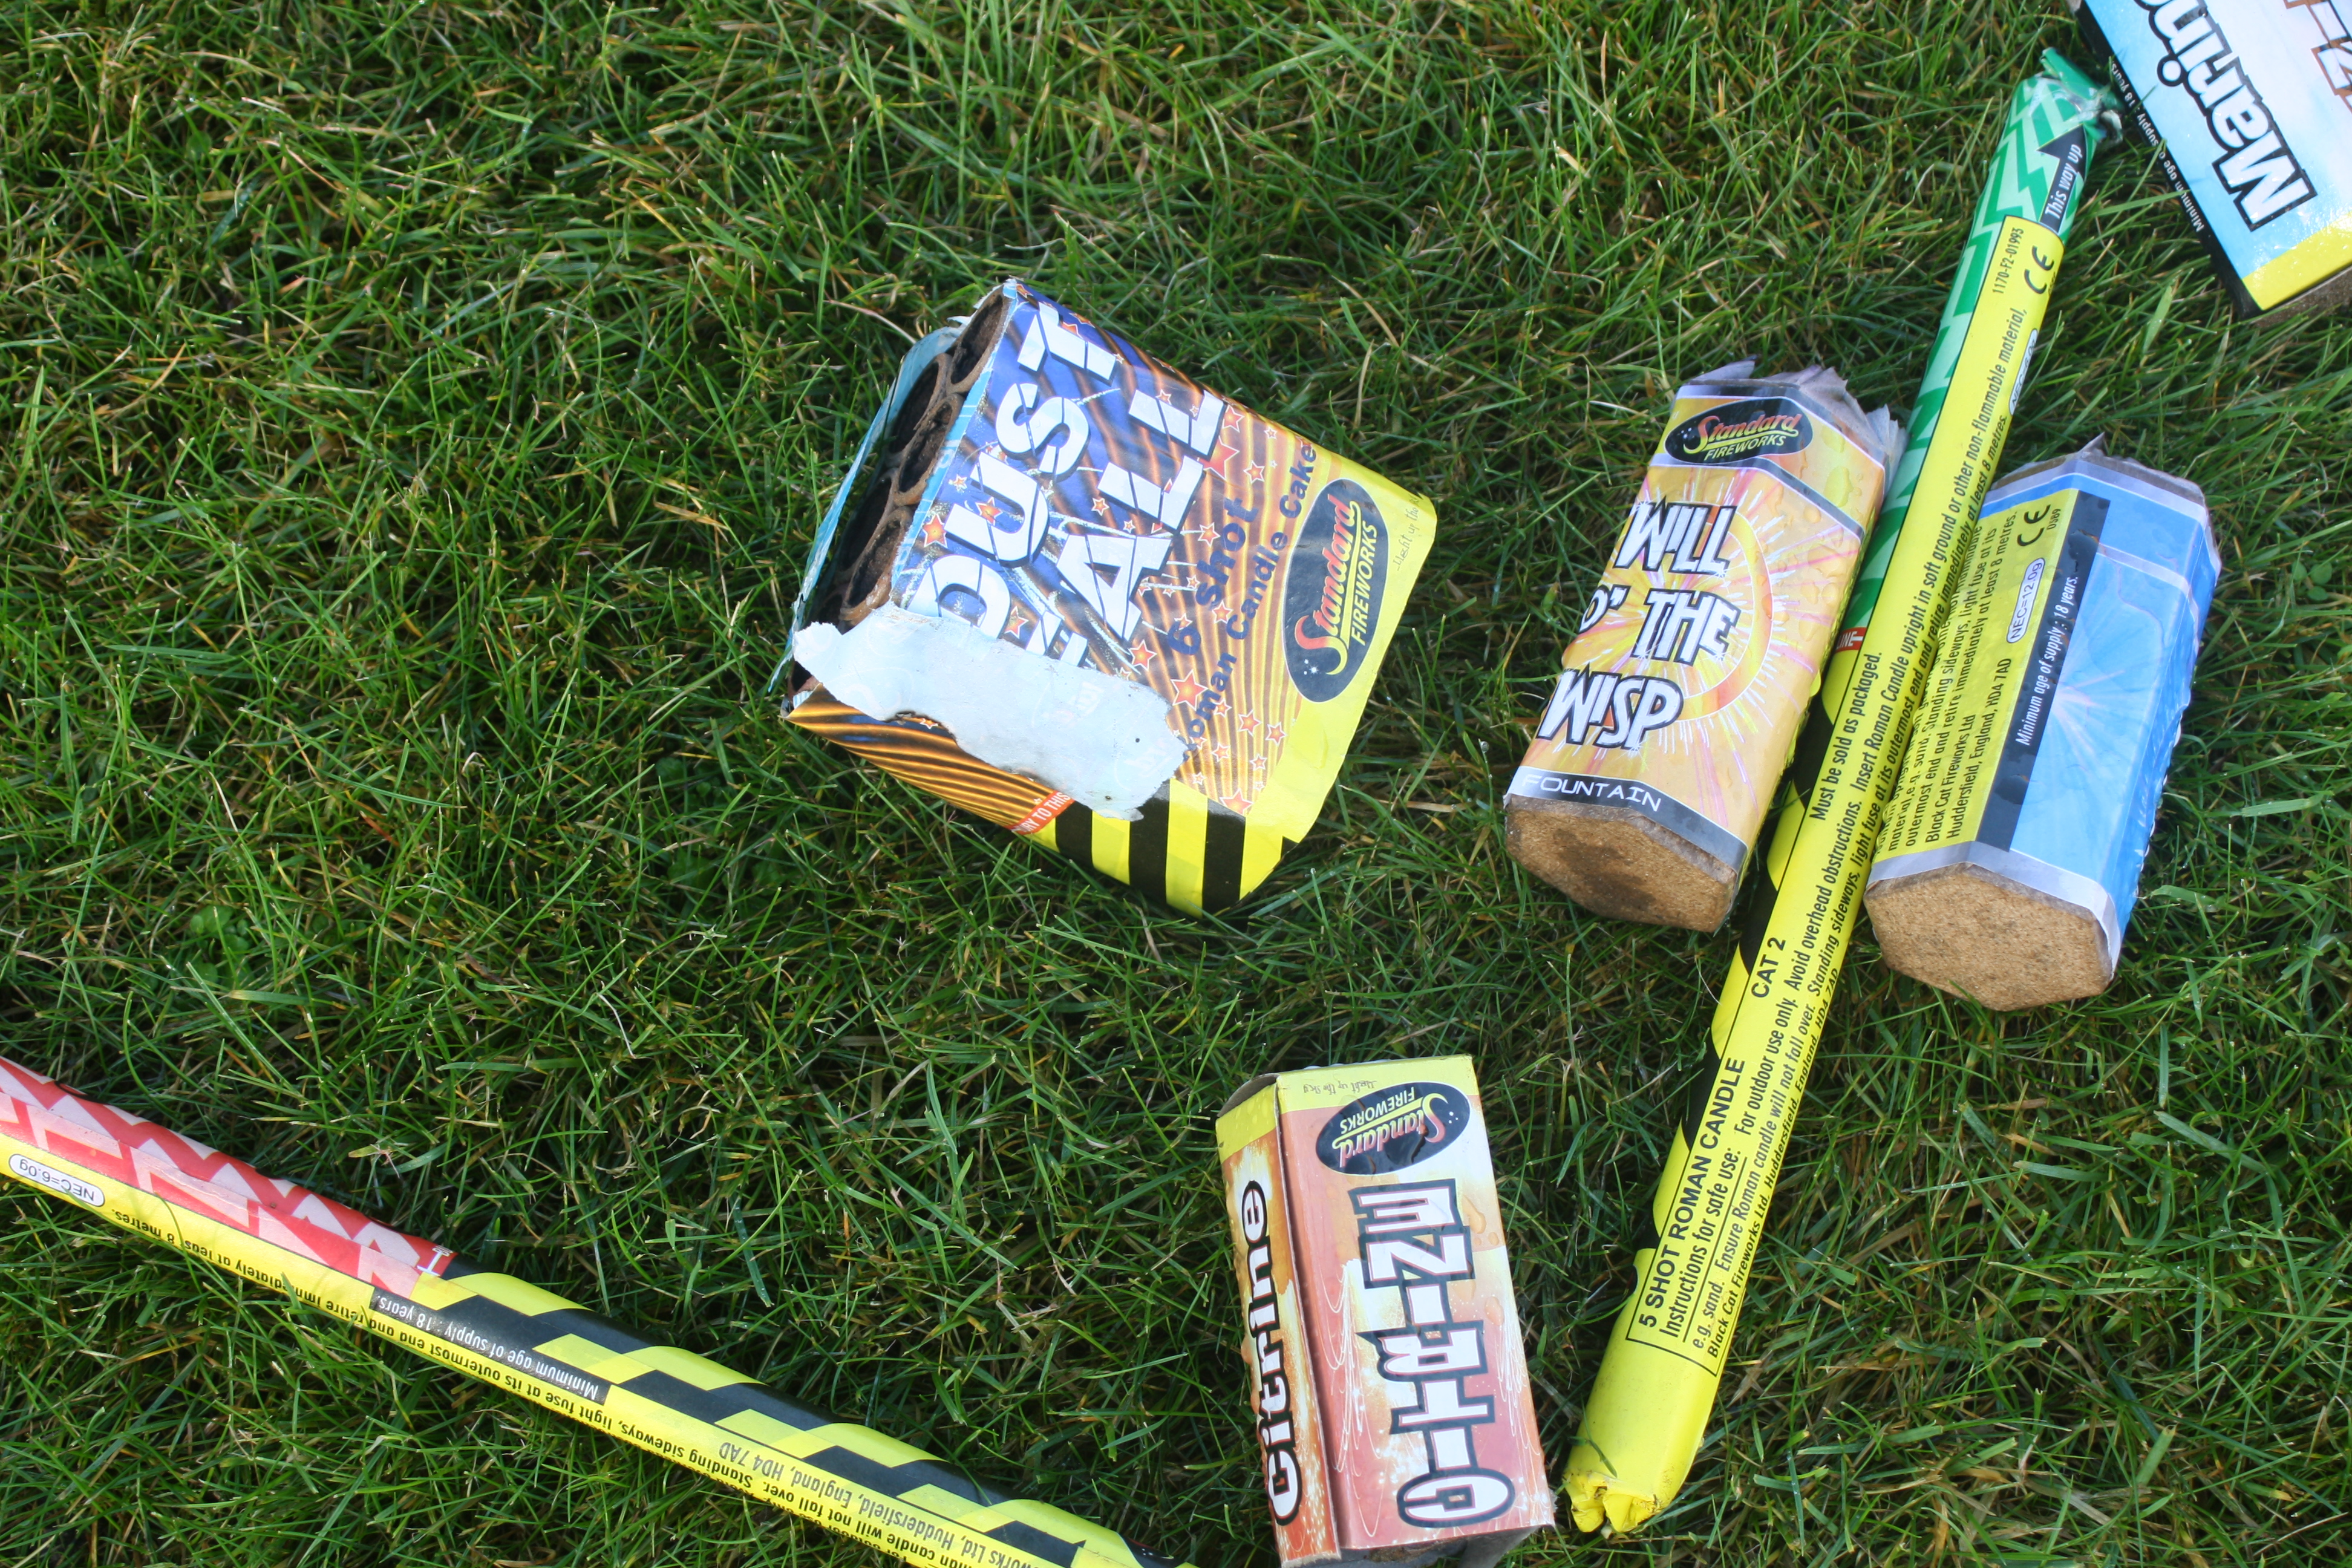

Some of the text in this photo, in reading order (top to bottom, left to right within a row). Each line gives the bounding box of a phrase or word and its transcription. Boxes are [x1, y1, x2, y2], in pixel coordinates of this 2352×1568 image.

[2135, 0, 2316, 230] Marin
[2124, 91, 2178, 181] age supply 18
[2044, 143, 2082, 218] This way up
[1991, 227, 2024, 293] 1170-F2-01993
[2024, 246, 2054, 295] CE
[1998, 307, 2027, 363] material,
[1965, 364, 2006, 461] non-flammable
[1683, 413, 1803, 454] Standard
[1704, 434, 1786, 462] FIREWORKS
[1987, 415, 2007, 462] metres.
[906, 302, 1117, 639] DUST
[1953, 460, 1973, 497] other
[1981, 460, 1991, 472] 8
[1948, 497, 1962, 513] or
[1969, 471, 1988, 505] least
[1056, 389, 1224, 642] ALL
[1967, 505, 1981, 523] at
[2016, 504, 2051, 547] CE
[1612, 495, 1737, 577] WILL
[1932, 512, 1956, 563] ground
[1349, 518, 1379, 647] FIREWORKS
[1922, 561, 1941, 589] soft
[1937, 521, 1976, 604] immediately
[1183, 442, 1318, 753] oman Candle Cake
[1293, 494, 1359, 676] Standard
[1913, 589, 1932, 604] in
[2009, 560, 2042, 641] NEC=12.0g
[1171, 622, 1201, 656] 6
[1630, 587, 1742, 667] THE
[1900, 605, 1926, 654] upright
[1927, 603, 1949, 643] retire
[1918, 639, 1936, 669] and
[2015, 577, 2078, 745] Minimum age of supply 18 years.
[1880, 656, 1909, 702] Candle
[1909, 667, 1924, 696] end
[1535, 662, 1684, 751] WISP
[1808, 652, 1882, 820] Must be sold as packaged.
[1863, 704, 1893, 751] Roman
[1886, 696, 1915, 765] outermost
[1905, 782, 1933, 846] outermost
[1925, 757, 1941, 779] end
[1934, 731, 1950, 754] and
[1952, 617, 1988, 691] immediately
[1945, 658, 2011, 838] Huddersfield, England, HD4 7AD
[1849, 751, 1878, 792] Insert
[1877, 765, 1893, 785] its
[1924, 714, 1976, 843] Black Cat Fireworks Ltd
[1031, 791, 1071, 821] TO THIS
[1521, 774, 1662, 812] FOUNTAIN
[1874, 784, 1889, 802] at
[1861, 802, 1885, 833] fuse
[1821, 801, 1862, 884] obstructions.
[1849, 832, 1876, 867] light
[1801, 884, 1832, 949] overhead
[1830, 872, 1861, 933] sideways,
[1783, 950, 1811, 991] Avoid
[1807, 934, 1840, 996] Standing
[1774, 997, 1798, 1028] only.
[1798, 1003, 1815, 1036] over.
[1765, 1030, 1784, 1054] use
[1785, 1035, 1804, 1063] fall
[1746, 1055, 1775, 1109] outdoor
[1779, 1063, 1795, 1089] not
[1339, 1086, 1416, 1134] FIREWORKS
[1733, 1111, 1756, 1135] For
[1769, 1089, 1786, 1118] will
[1331, 1093, 1448, 1168] Standard
[1638, 936, 1786, 1327] 5 SHOT ROMAN CANDLE CAT 2
[1753, 1120, 1777, 1168] candle
[16, 1158, 97, 1201] NEC=6.0g
[1707, 967, 1843, 1358] Black Cat Fireworks Ltd, Huddersfield, England, HD4 7AD
[1717, 1147, 1740, 1180] use:
[1705, 1183, 1728, 1217] safe
[1731, 1171, 1761, 1221] Roman
[112, 1209, 162, 1240] metres.
[162, 1232, 174, 1246] 8
[1691, 1218, 1716, 1242] for
[217, 1253, 230, 1266] at
[1714, 1223, 1743, 1272] Ensure
[1658, 1244, 1707, 1338] Instructions
[1702, 1280, 1725, 1319] sand.
[377, 1295, 598, 1400] Minimum age of supply 18 years.
[1241, 1180, 1302, 1526] Citrine
[1692, 1324, 1711, 1348] e.g.
[425, 1344, 500, 1380] outermost
[505, 1374, 522, 1392] its
[526, 1383, 541, 1397] at
[545, 1392, 574, 1414] fuse
[578, 1406, 612, 1430] light
[618, 1420, 684, 1457] sideways,
[688, 1448, 753, 1488] Standing
[718, 1442, 750, 1466] 7AD
[751, 1454, 784, 1481] HD4
[763, 1481, 794, 1502] over.
[790, 1466, 852, 1509] England,
[798, 1497, 823, 1517] fall
[827, 1508, 852, 1526] not
[855, 1520, 881, 1539] will
[857, 1493, 955, 1550] Huddersfield,
[886, 1533, 935, 1560] candle
[960, 1535, 986, 1563] Ltd,
